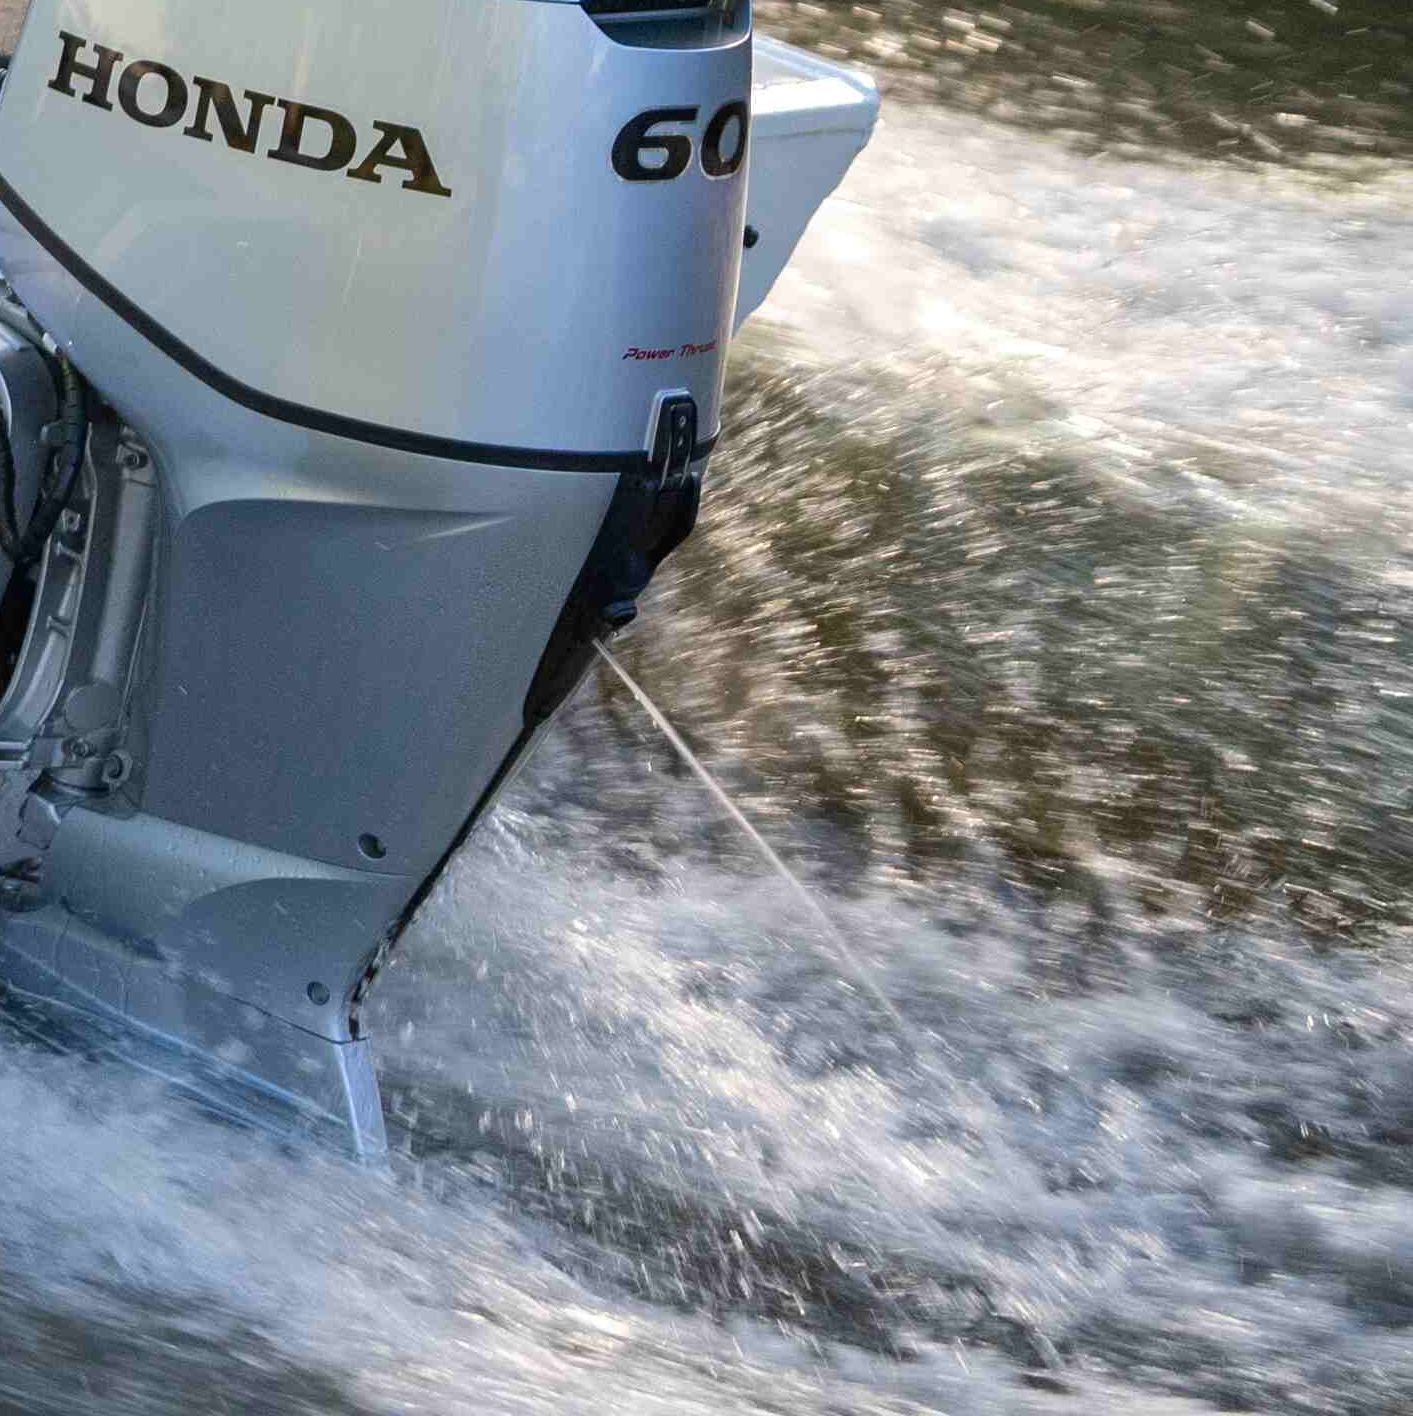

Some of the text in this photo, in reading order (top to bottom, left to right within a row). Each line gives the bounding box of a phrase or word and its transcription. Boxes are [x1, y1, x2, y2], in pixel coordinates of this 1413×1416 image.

[47, 30, 452, 198] HONDA
[611, 101, 749, 181] 60
[622, 347, 675, 360] Power
